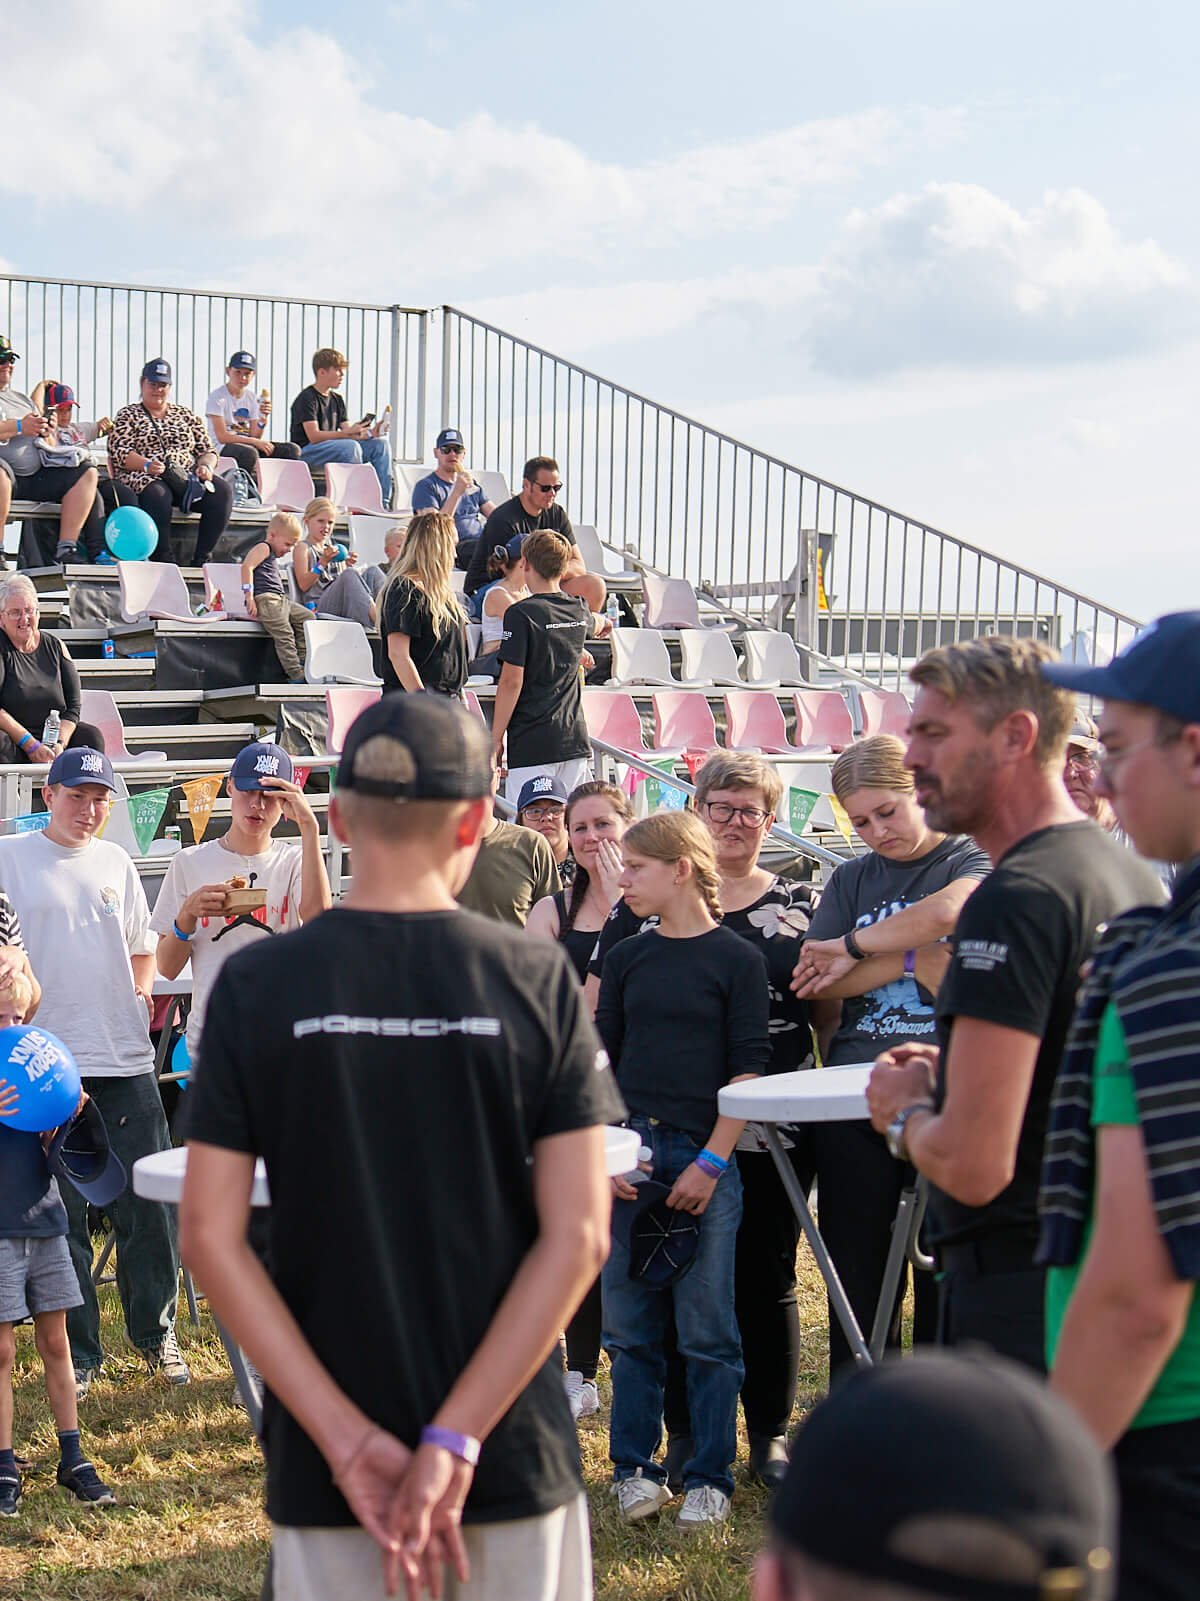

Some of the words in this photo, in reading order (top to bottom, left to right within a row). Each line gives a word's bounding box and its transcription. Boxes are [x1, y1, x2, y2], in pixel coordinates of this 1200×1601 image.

[545, 621, 586, 630] PORSCHE
[293, 1014, 501, 1039] PORSCHE
[7, 1030, 47, 1066] KNUS
